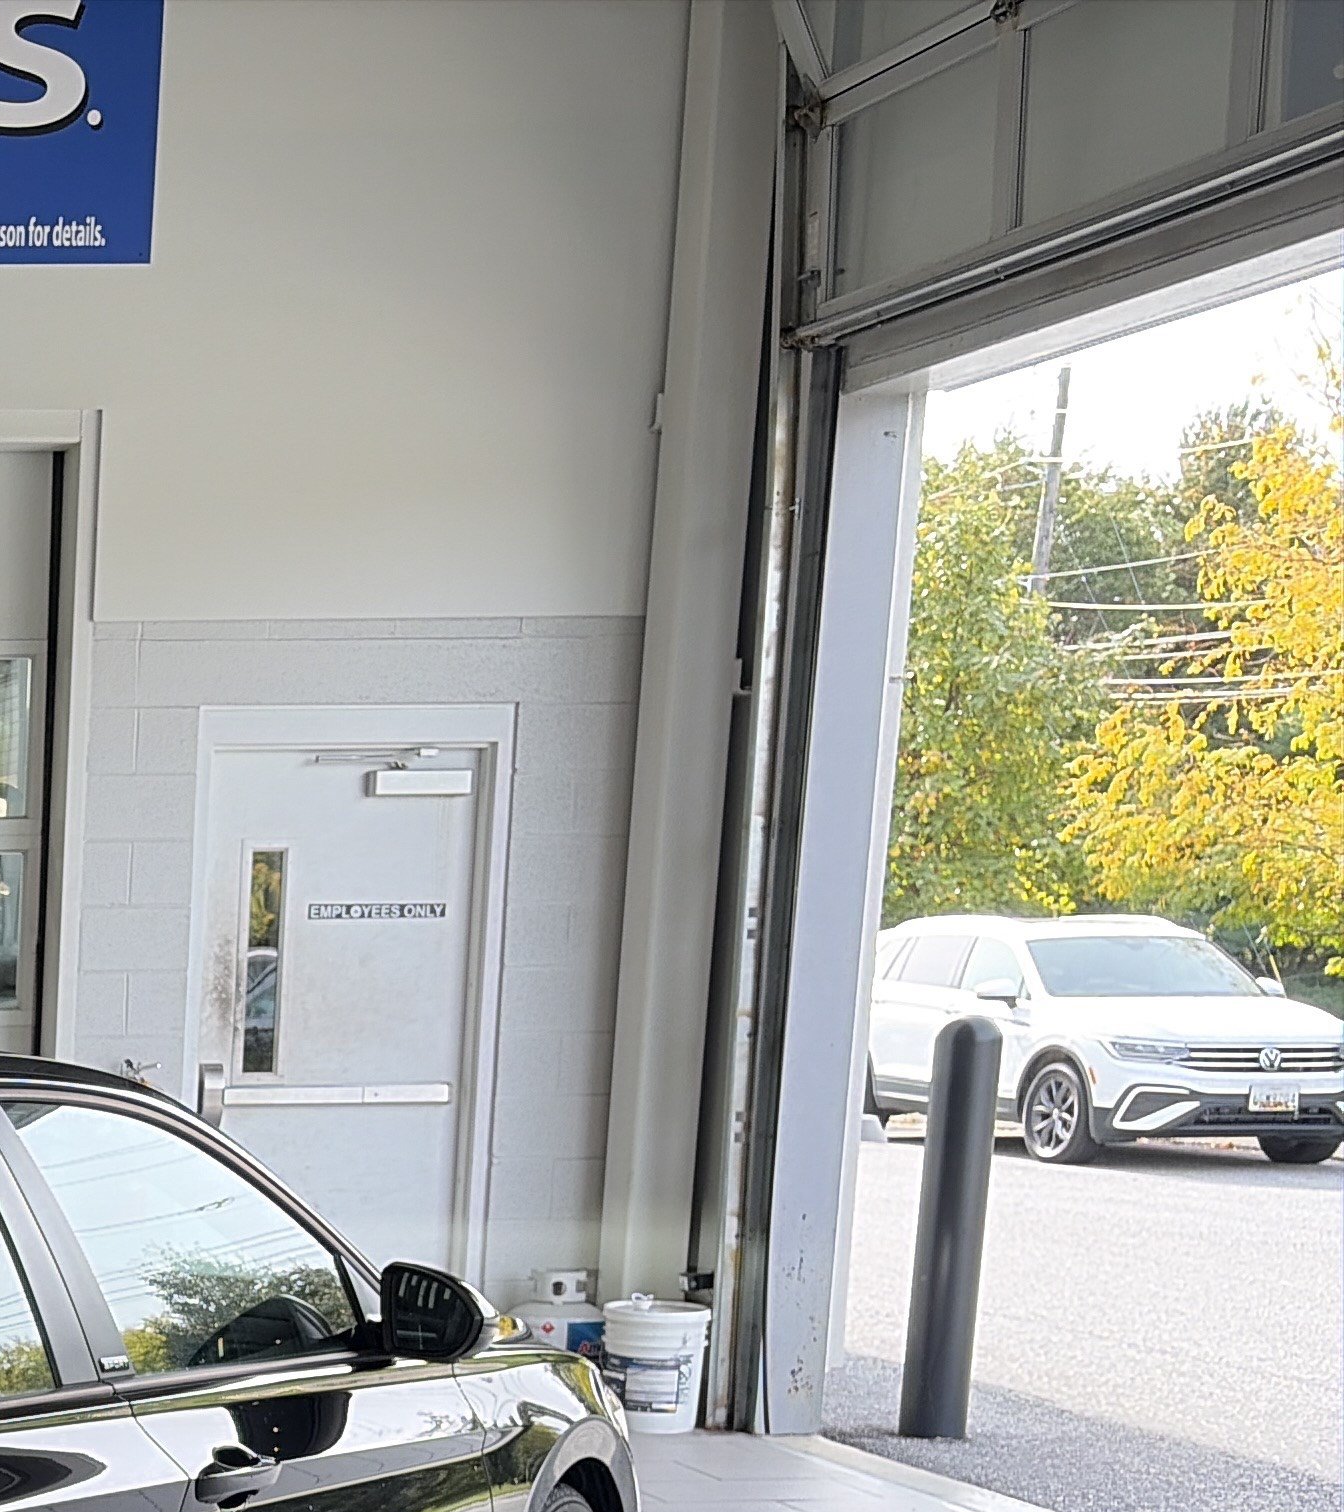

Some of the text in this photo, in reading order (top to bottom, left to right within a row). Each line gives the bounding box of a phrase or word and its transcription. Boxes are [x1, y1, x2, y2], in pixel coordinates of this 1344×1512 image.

[28, 216, 51, 246] for
[52, 216, 106, 246] details.
[311, 903, 444, 918] EMPLOYEES ONLY
